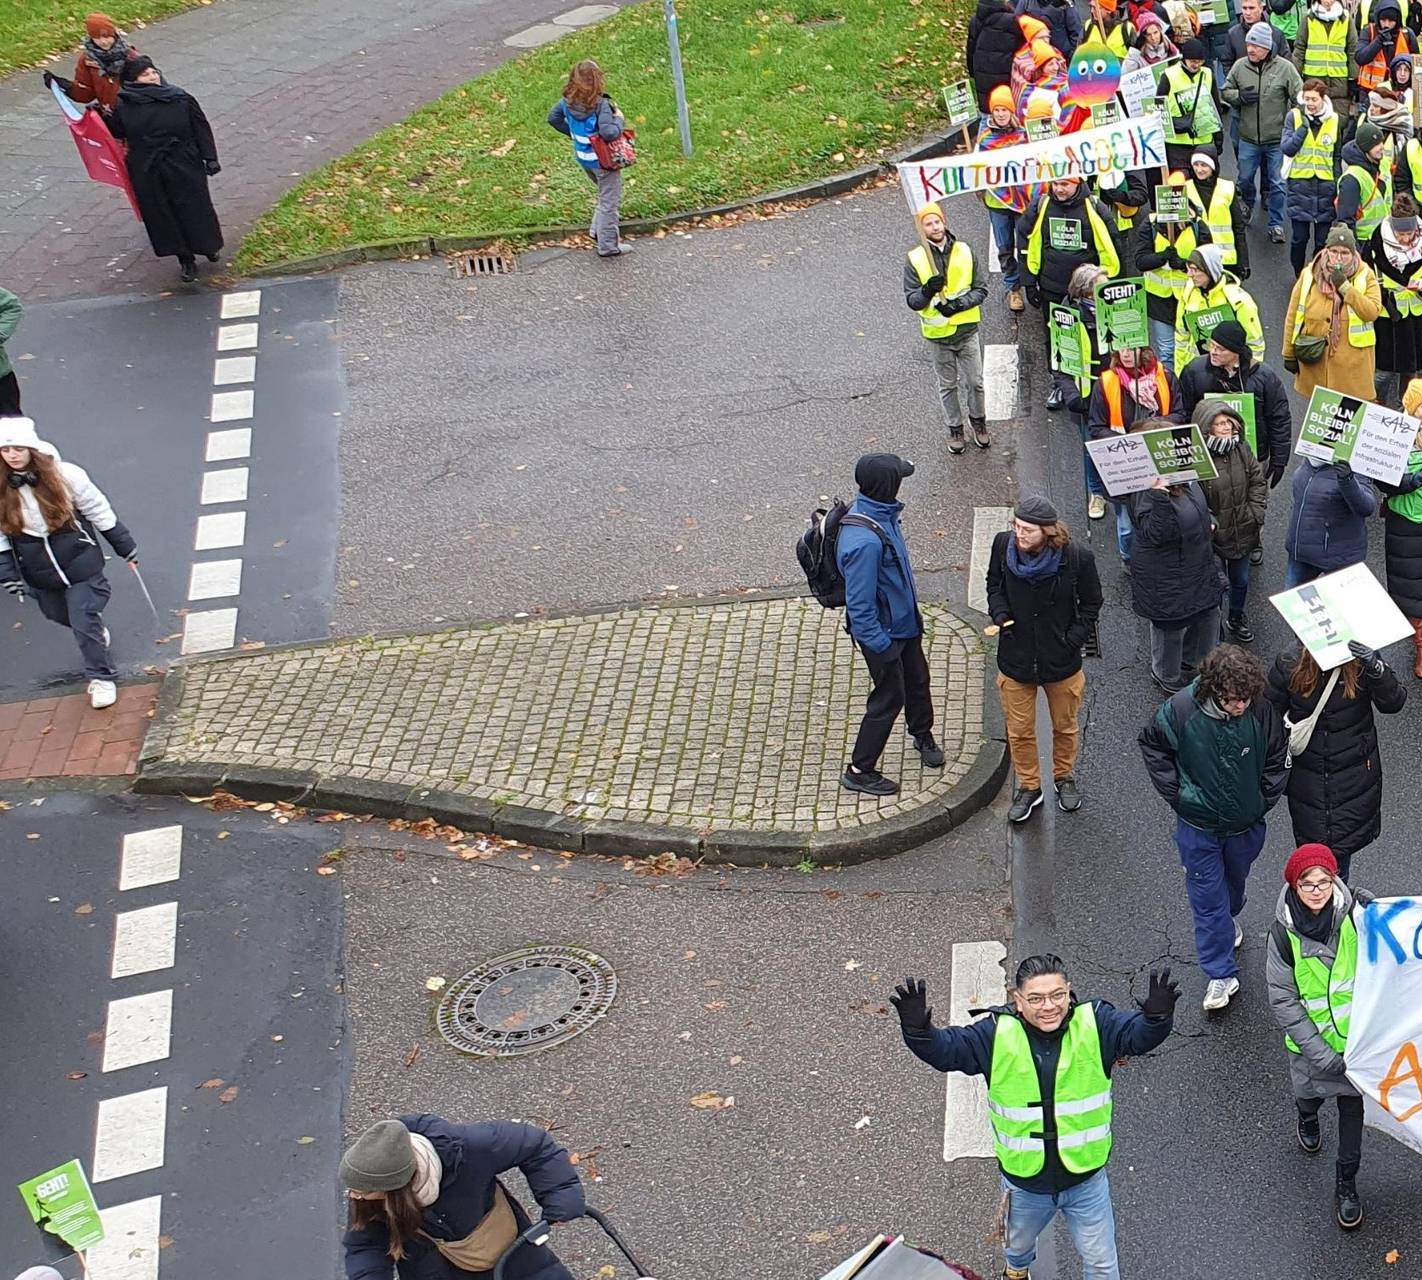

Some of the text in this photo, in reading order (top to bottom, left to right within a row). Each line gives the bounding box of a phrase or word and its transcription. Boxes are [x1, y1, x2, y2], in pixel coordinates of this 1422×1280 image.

[1103, 284, 1136, 300] STEHT!
[1197, 310, 1223, 327] GEHT!
[1320, 402, 1355, 420] KÖLN
[1156, 435, 1192, 449] KÖLN
[1307, 424, 1352, 446] SOZIAL!
[1158, 454, 1206, 469] SOZIAL!
